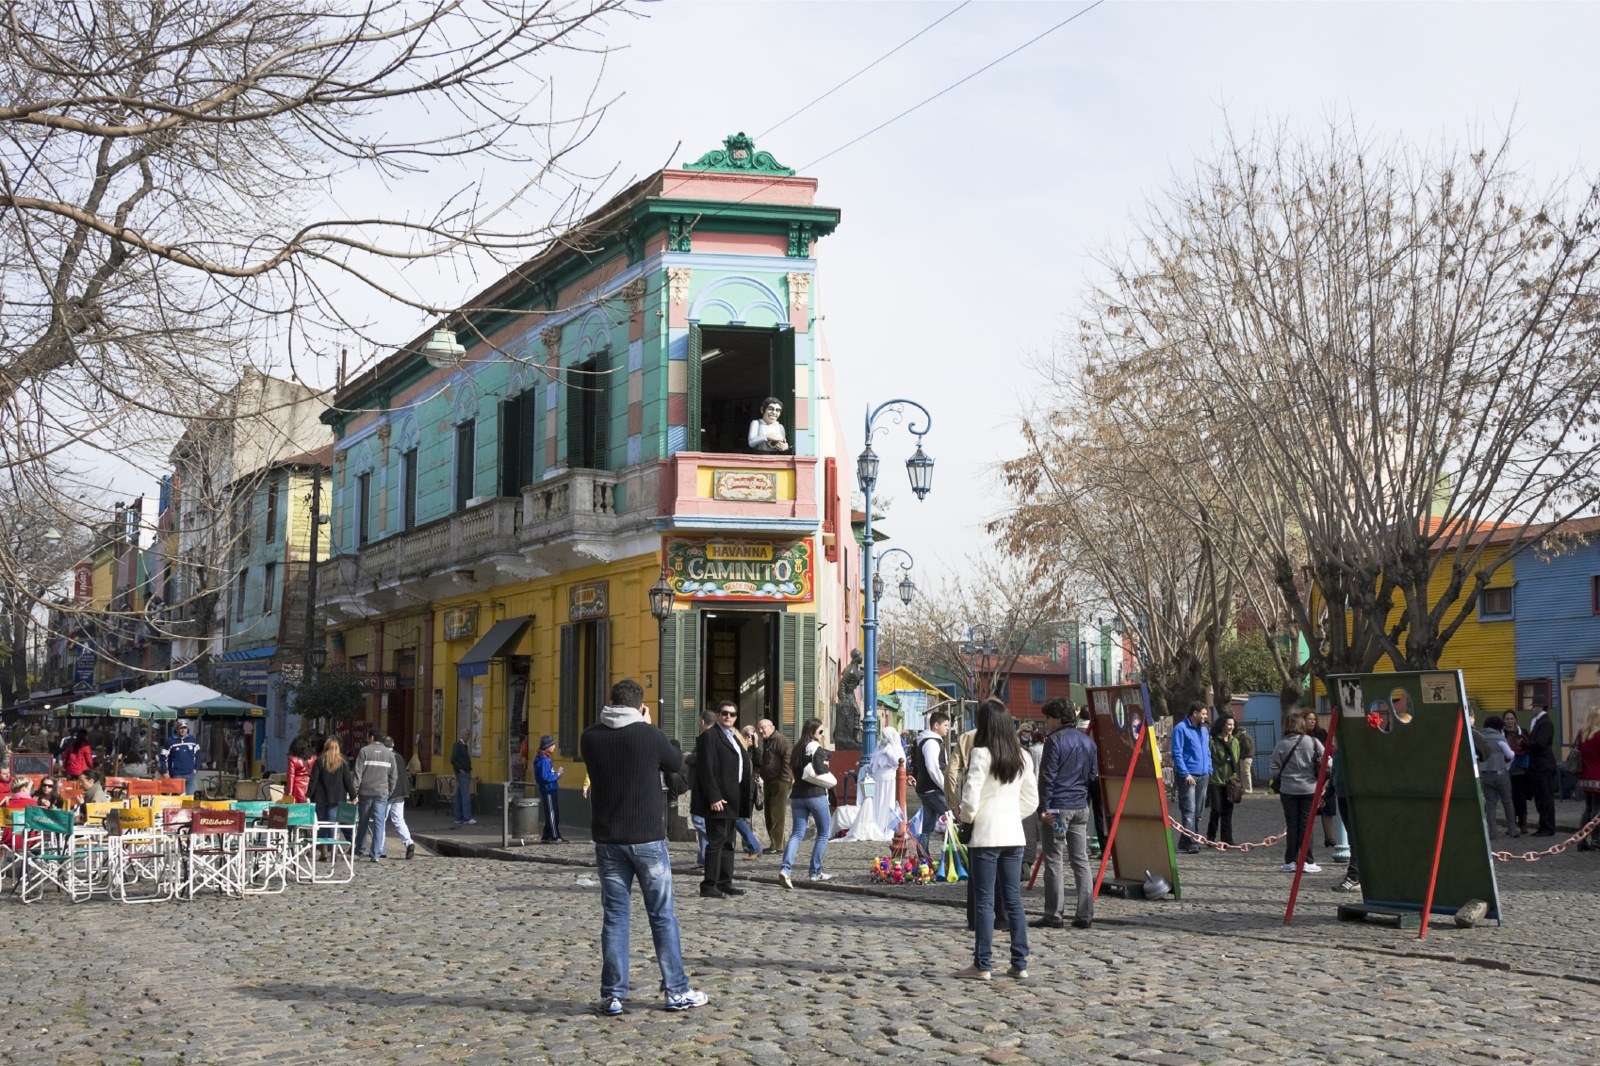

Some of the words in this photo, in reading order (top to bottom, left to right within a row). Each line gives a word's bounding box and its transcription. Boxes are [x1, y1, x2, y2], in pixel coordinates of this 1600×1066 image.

[713, 545, 768, 558] HAVANNA
[687, 557, 792, 581] CAMINITO
[199, 817, 236, 826] Filiberto
